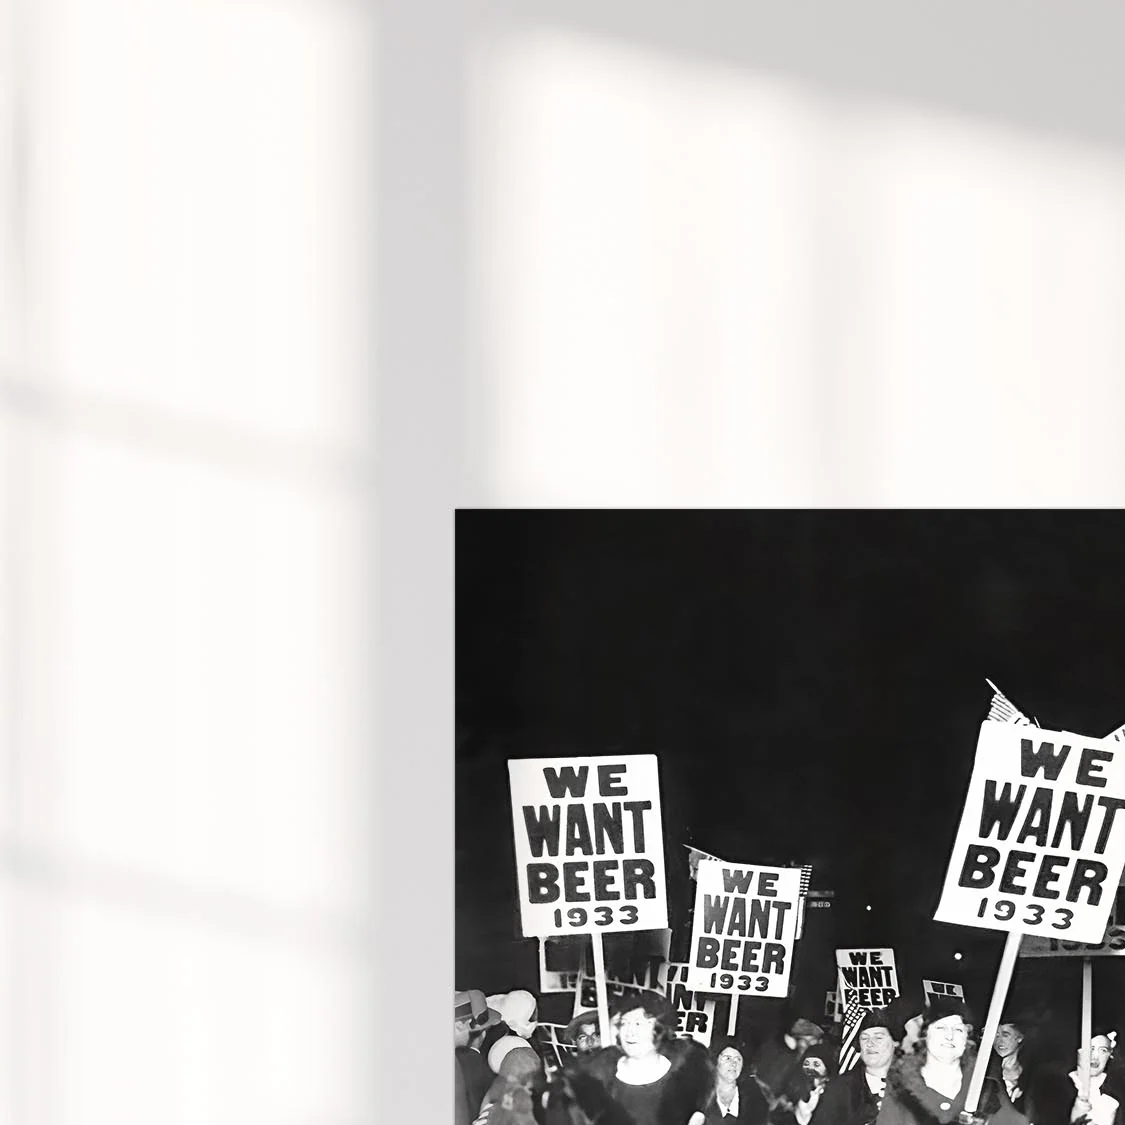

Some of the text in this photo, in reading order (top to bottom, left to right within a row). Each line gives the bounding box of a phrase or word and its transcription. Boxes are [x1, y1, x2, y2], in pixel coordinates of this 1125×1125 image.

[1021, 739, 1113, 787] WE
[543, 764, 628, 798] WE
[523, 801, 651, 857] WANT
[527, 860, 656, 904] BEER
[724, 869, 779, 897] WE
[958, 844, 1108, 906] BEER
[554, 906, 638, 927] 1933
[703, 896, 791, 940] WANT
[978, 898, 1073, 929] 1933
[696, 937, 786, 975] BEER
[848, 951, 884, 965] WE
[711, 973, 769, 991] 1933
[841, 966, 893, 988] WANT
